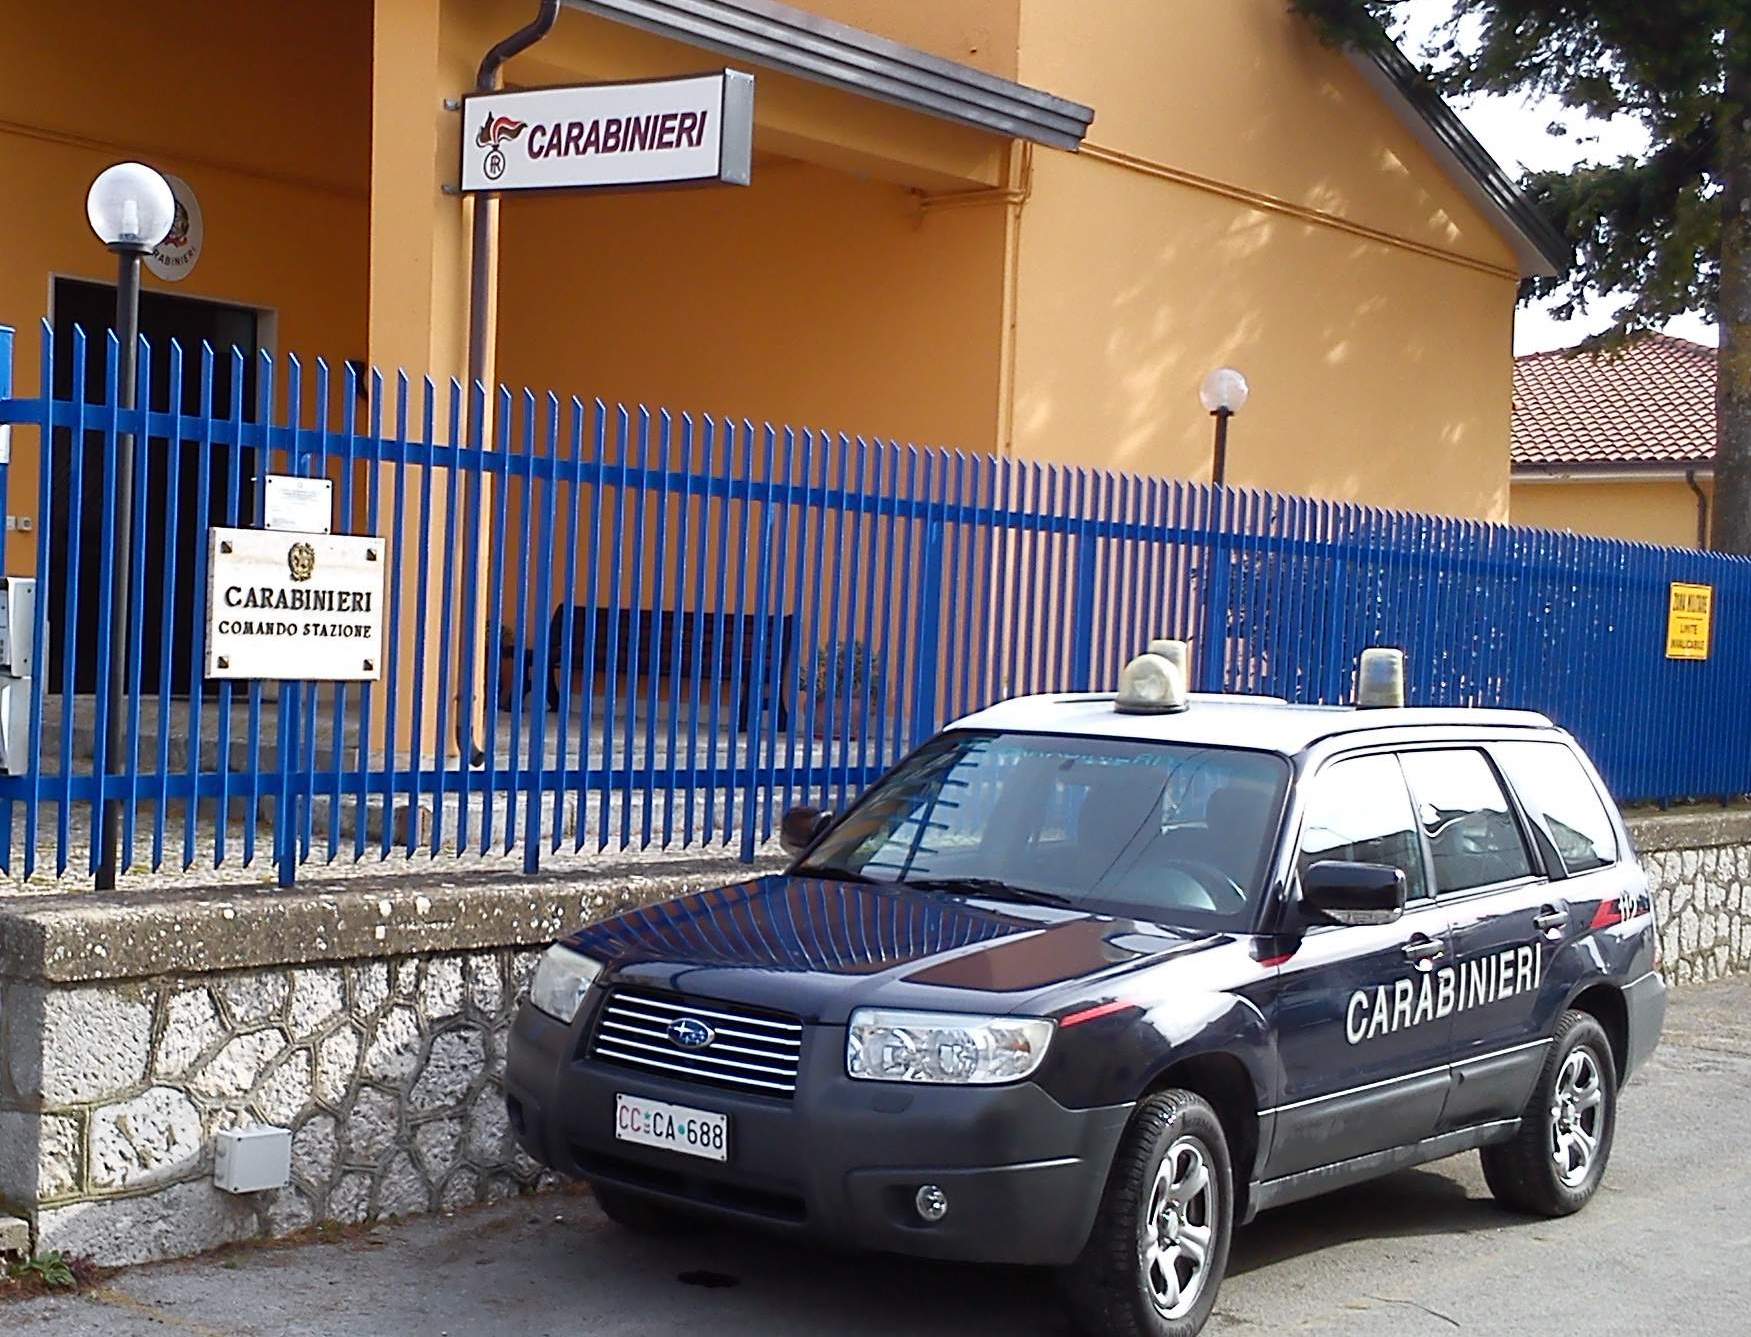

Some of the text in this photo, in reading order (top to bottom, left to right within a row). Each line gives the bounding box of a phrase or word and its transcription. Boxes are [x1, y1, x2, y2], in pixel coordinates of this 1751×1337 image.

[527, 111, 708, 160] CARABINIERI
[224, 586, 372, 613] CARABINIERI
[218, 620, 372, 638] COMANDO STAZIONE
[1346, 942, 1542, 1045] CARABINIERI
[618, 1104, 723, 1150] CC CA 688
